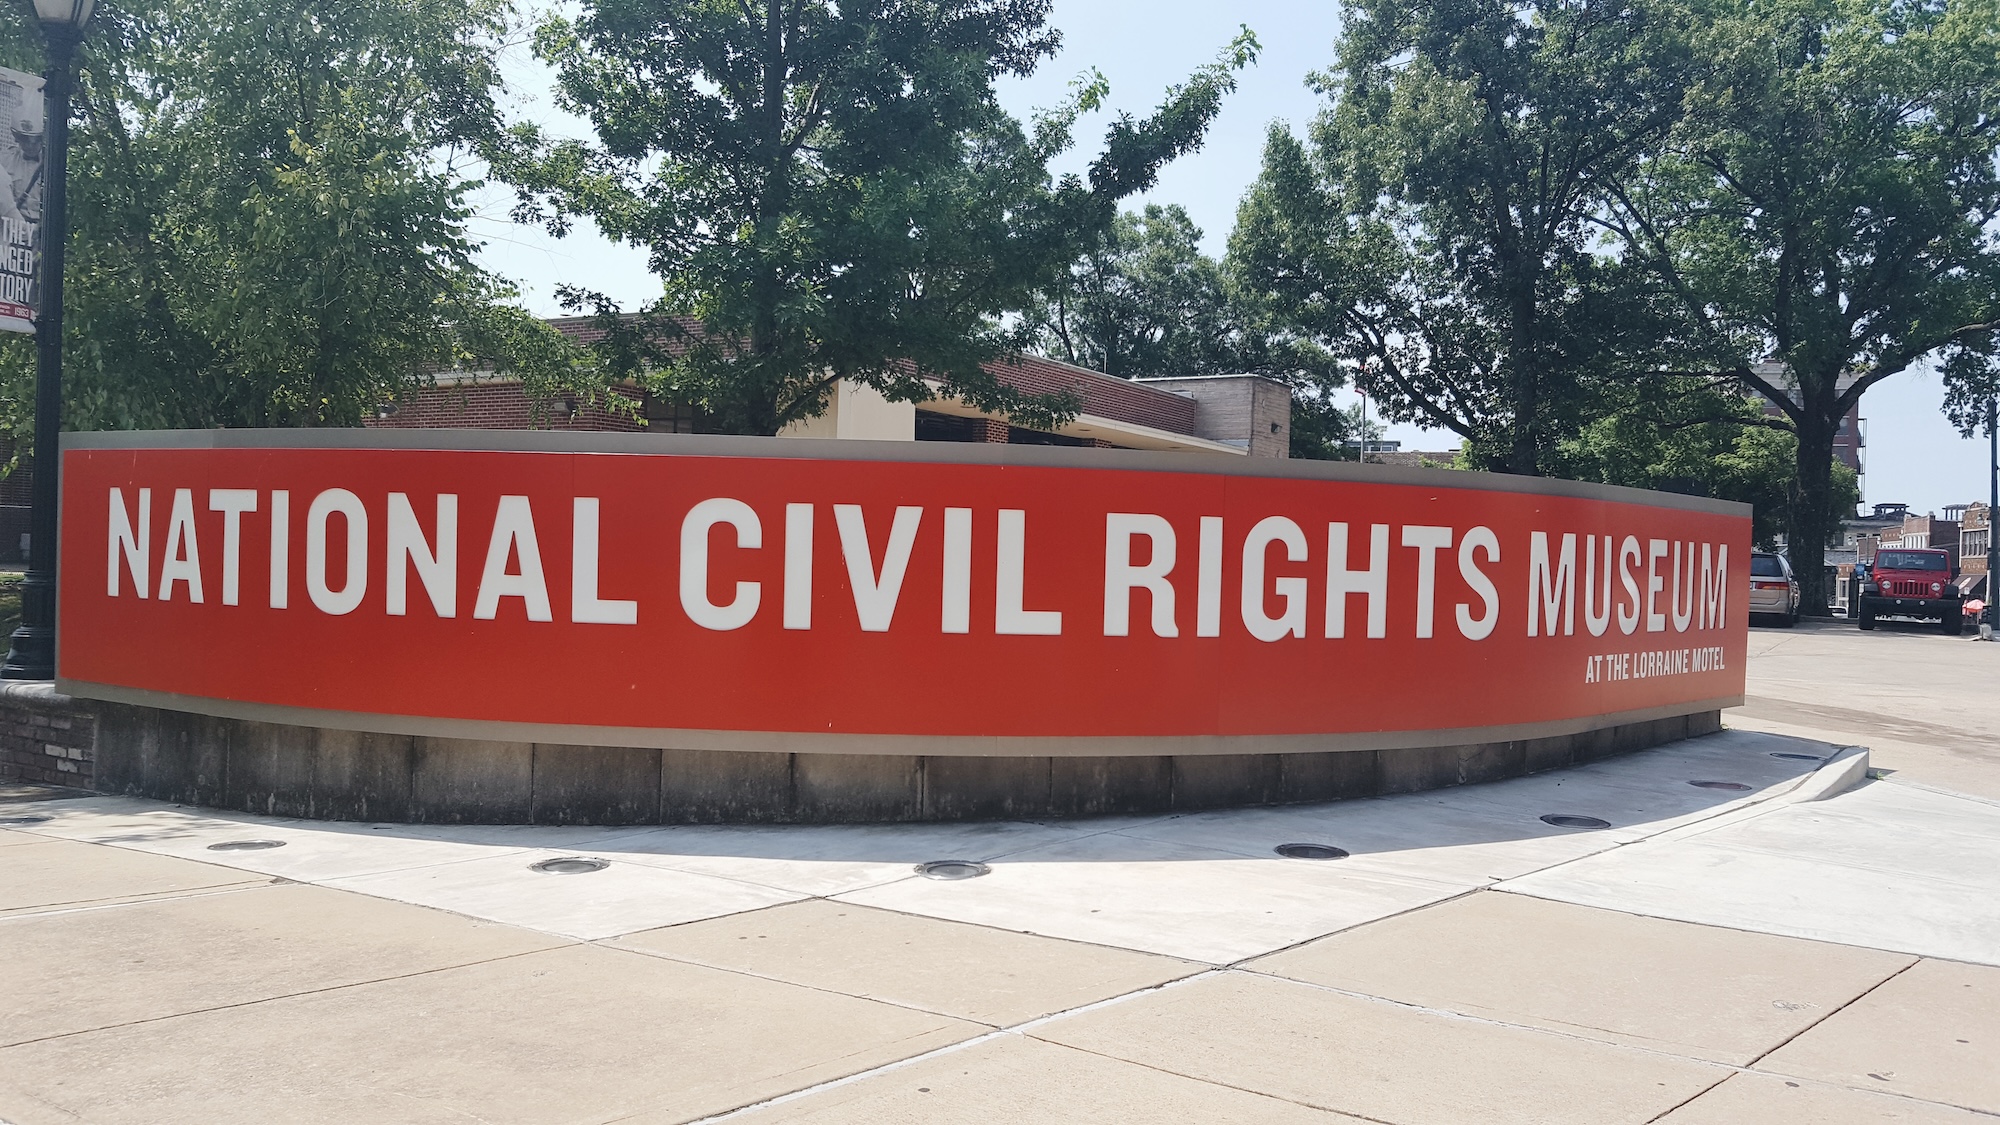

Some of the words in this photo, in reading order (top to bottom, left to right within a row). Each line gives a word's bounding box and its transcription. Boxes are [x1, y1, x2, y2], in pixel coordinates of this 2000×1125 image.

[1, 216, 35, 247] THEY
[107, 487, 638, 626] NATIONAL
[679, 497, 1063, 637] CIVIL
[1103, 512, 1501, 642] RIGHTS
[1527, 531, 1729, 639] MUSEUM
[1585, 655, 1603, 684] AT
[1606, 653, 1630, 682] THE
[1633, 648, 1690, 679] LORRAINE
[1692, 646, 1726, 673] MOTEL
